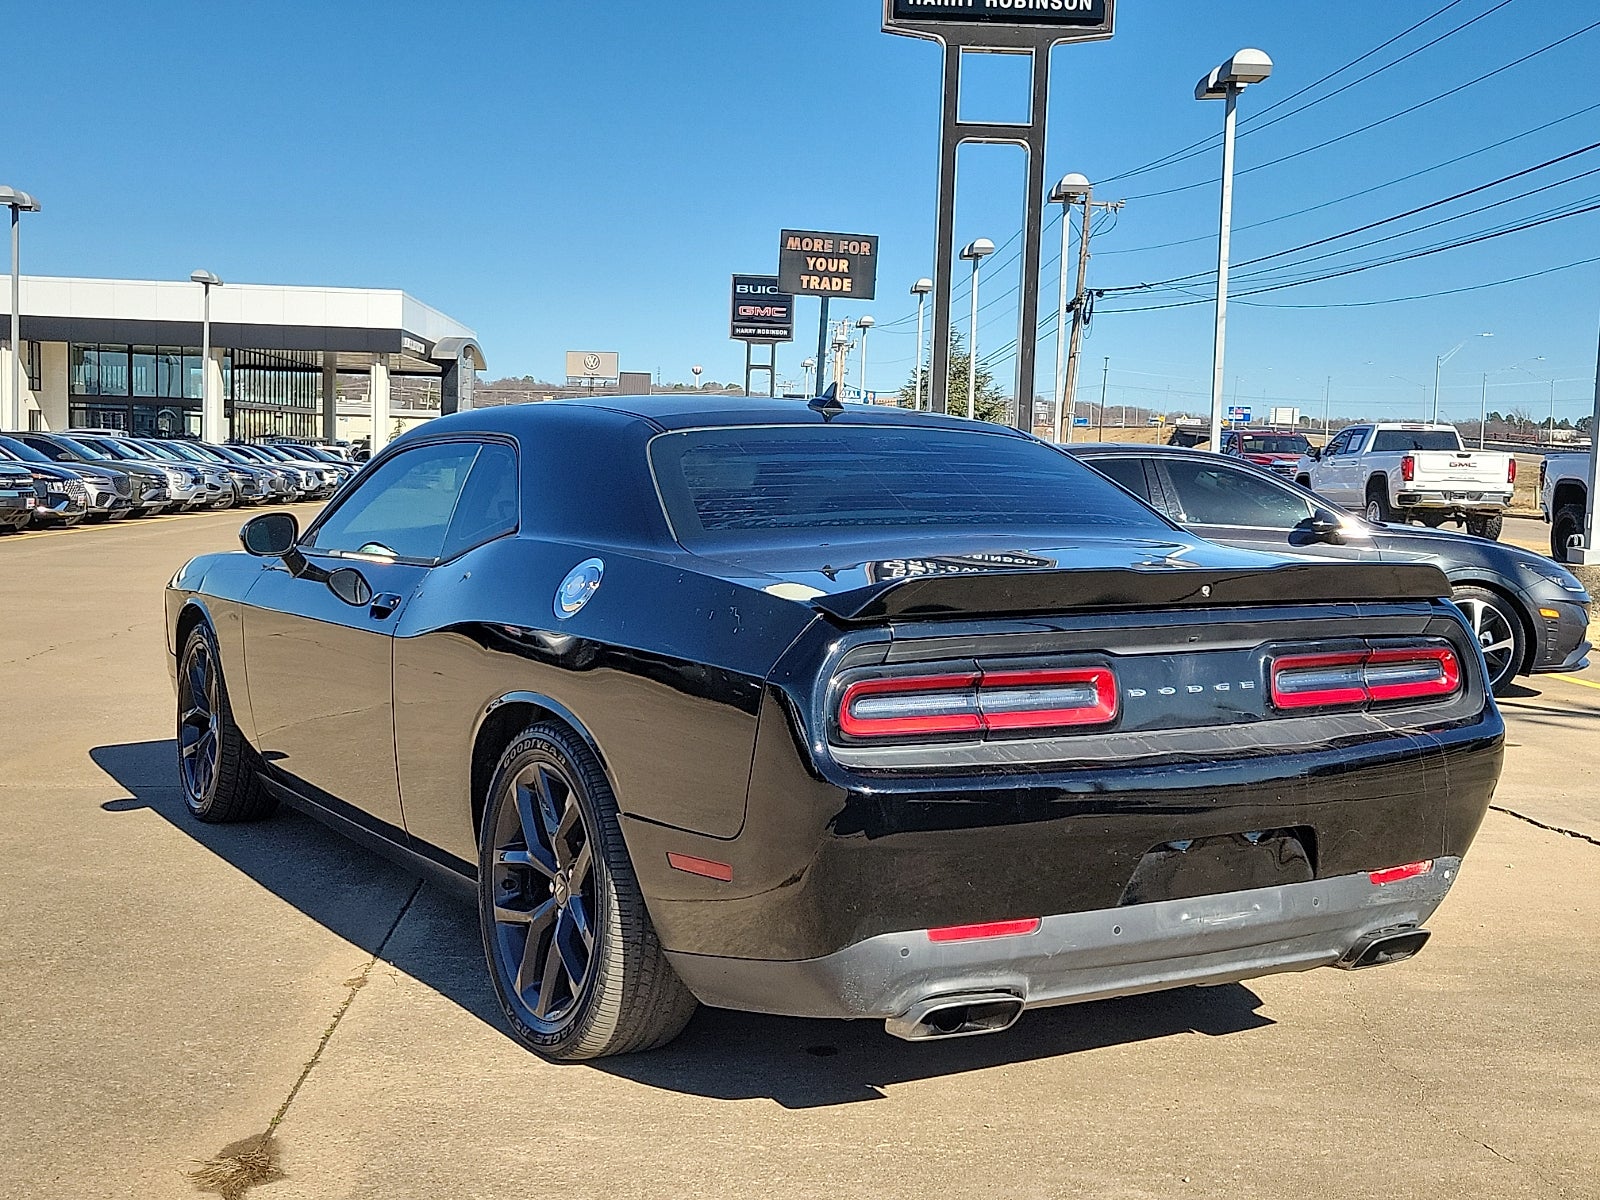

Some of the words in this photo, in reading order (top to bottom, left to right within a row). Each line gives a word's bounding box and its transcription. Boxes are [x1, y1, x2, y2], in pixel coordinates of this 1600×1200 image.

[786, 236, 833, 253] MORE
[839, 240, 871, 256] FOR
[806, 256, 849, 273] YOUR
[736, 284, 779, 294] BUIC
[800, 275, 852, 292] TRADE
[738, 305, 787, 318] GMC
[757, 328, 788, 336] ROBINSON
[1127, 680, 1256, 698] DODGE
[503, 739, 567, 769] GOODYEAR
[534, 1019, 576, 1045] EAGLE
